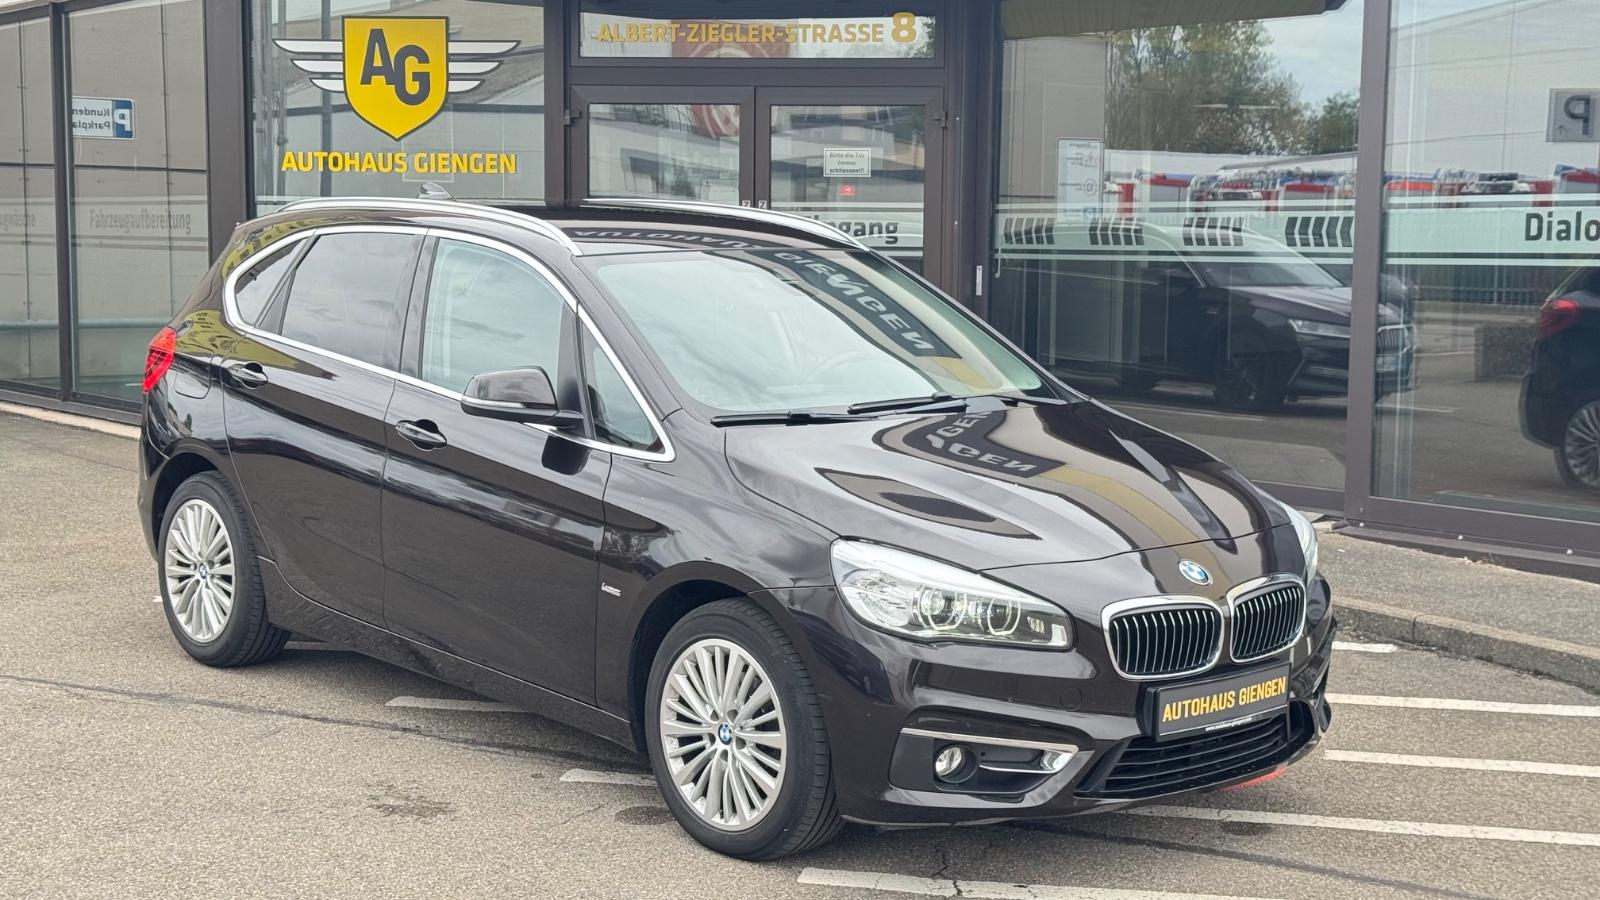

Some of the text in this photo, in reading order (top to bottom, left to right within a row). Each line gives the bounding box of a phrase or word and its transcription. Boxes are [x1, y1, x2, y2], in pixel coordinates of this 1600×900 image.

[597, 12, 917, 44] ALBERT-ZIEGLER-STRASSE 8
[360, 28, 431, 106] AG
[281, 152, 517, 174] AUTOHAUS GIENGEN
[89, 207, 191, 235] Fahrzeugaufbereitung
[1162, 676, 1287, 722] AUTOHAUS GIENGEN
